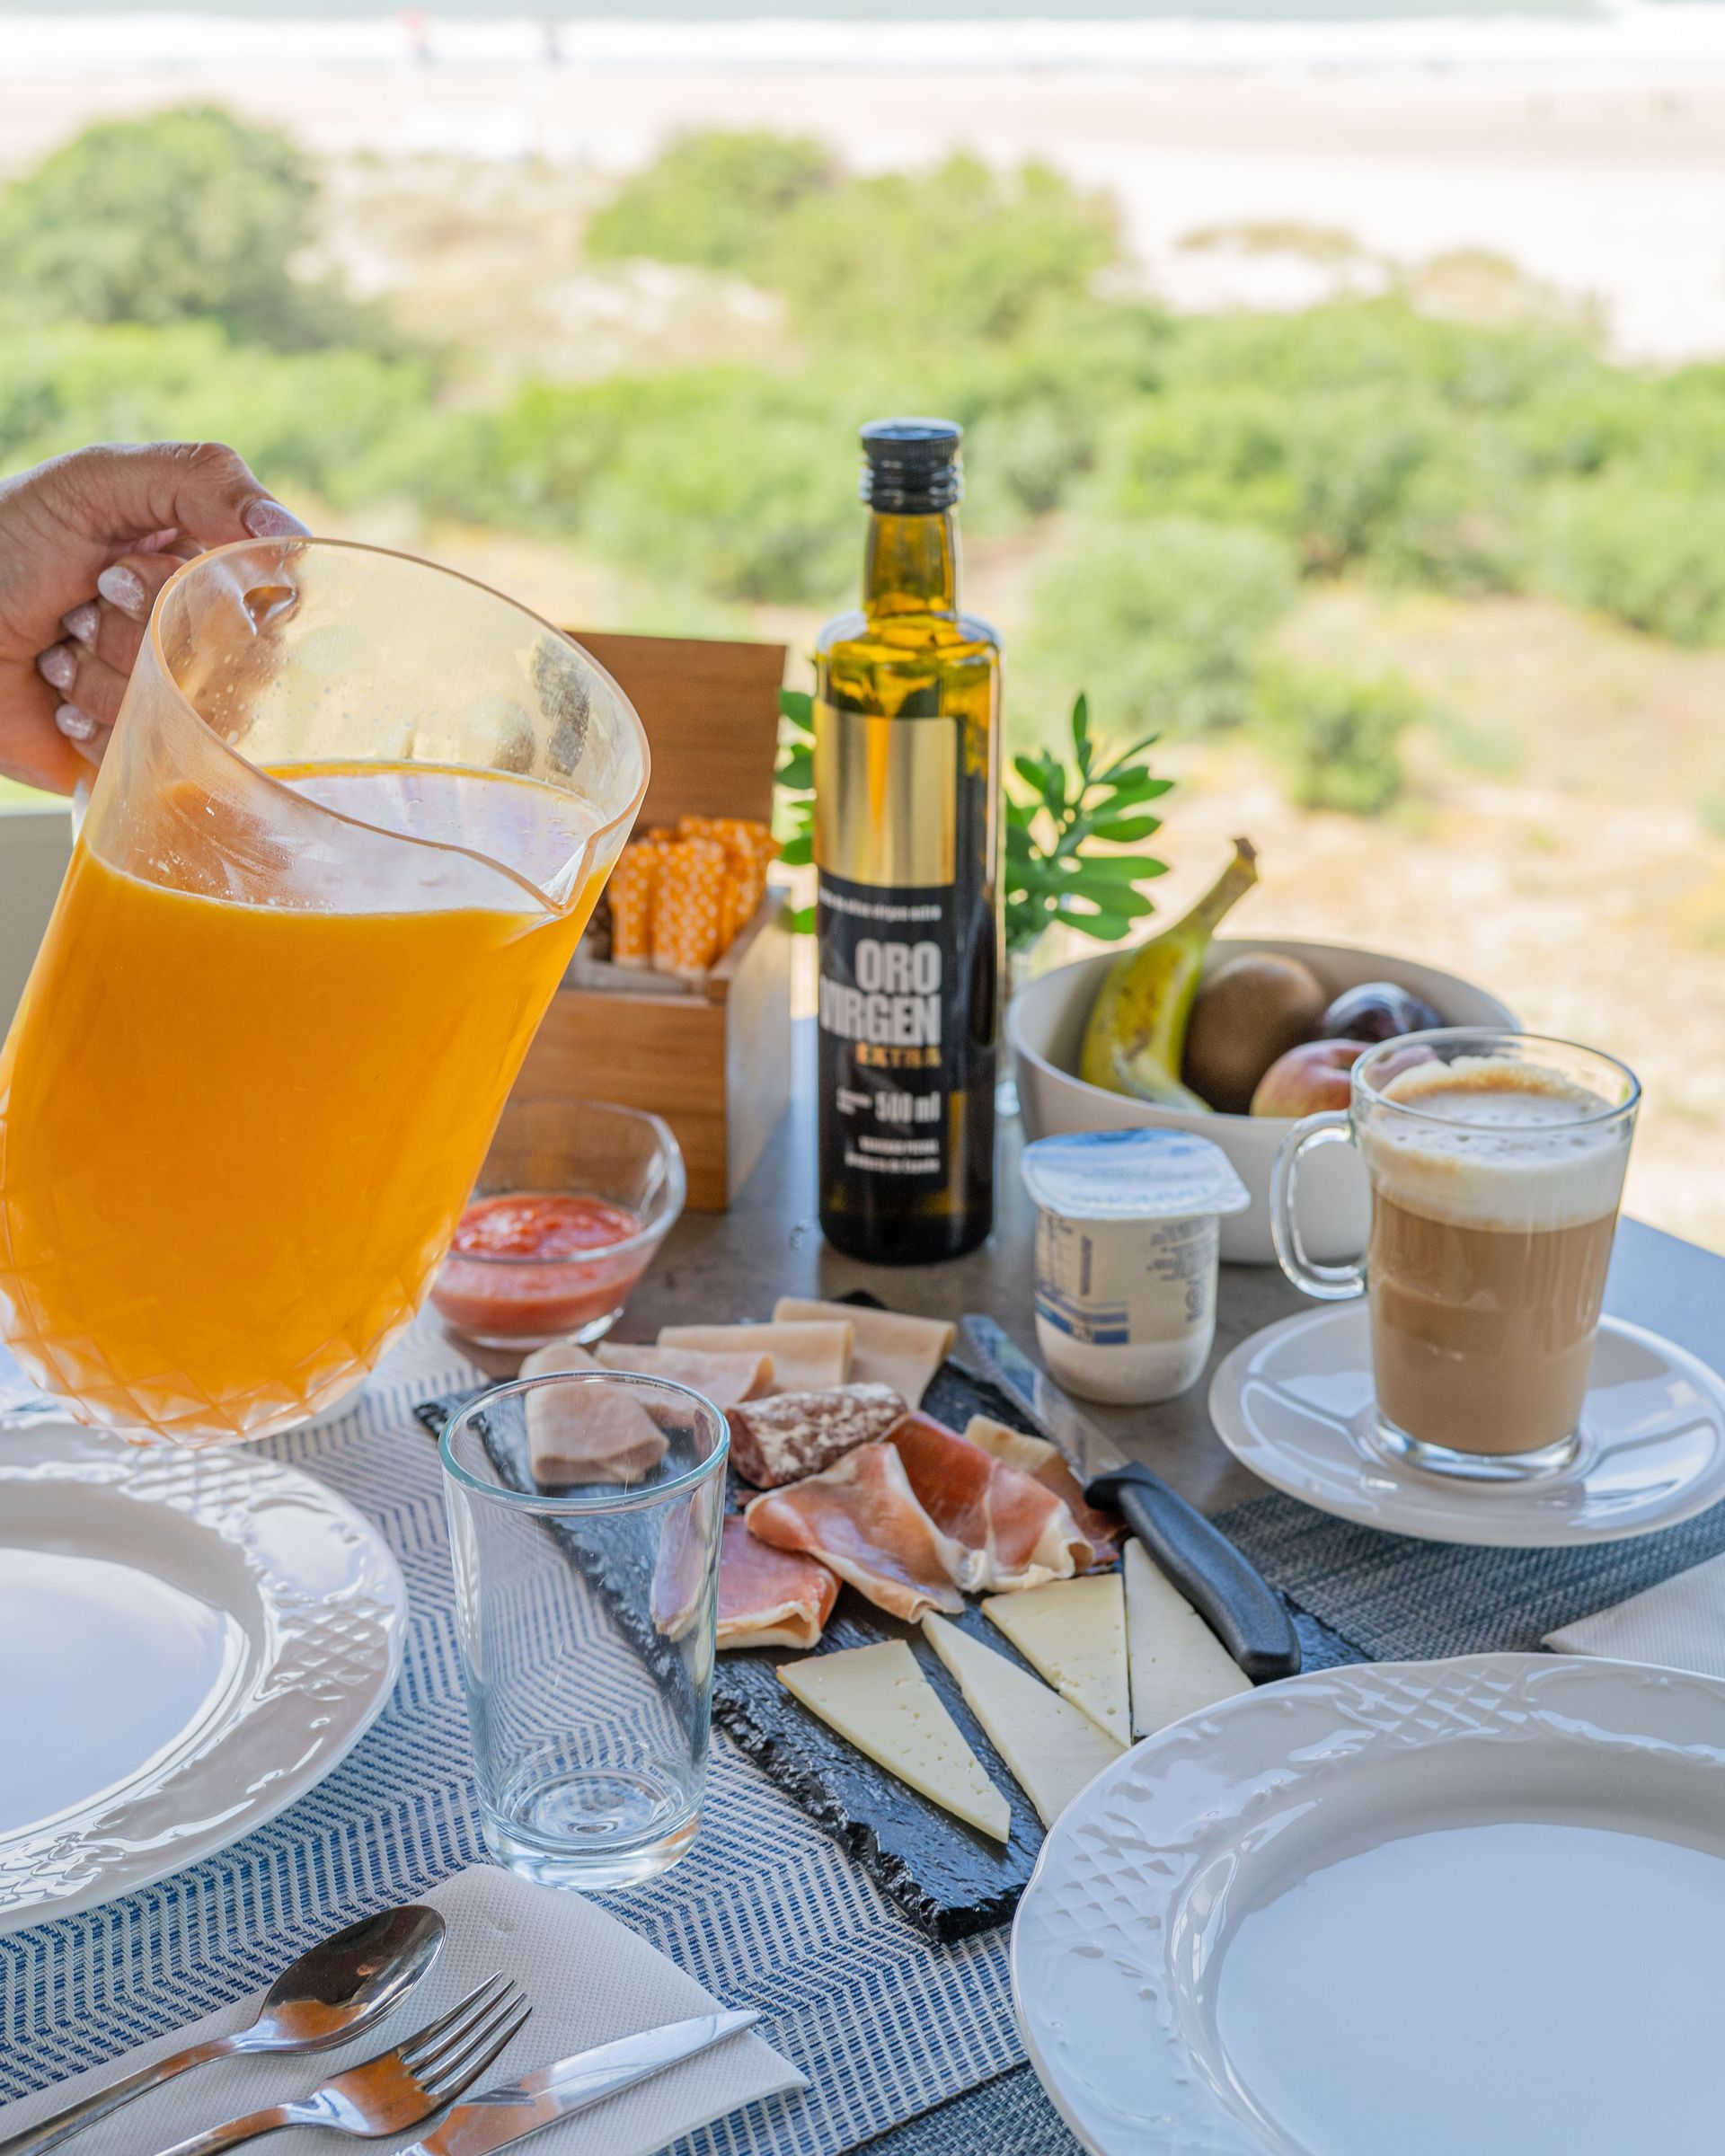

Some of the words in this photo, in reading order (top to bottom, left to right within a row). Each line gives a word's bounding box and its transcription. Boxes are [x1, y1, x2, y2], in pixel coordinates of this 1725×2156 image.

[855, 938, 942, 994] ORO
[818, 974, 942, 1046] VIRGEN
[855, 1040, 942, 1069] EXTRA
[875, 1091, 913, 1124] 500
[915, 1091, 941, 1123] ml
